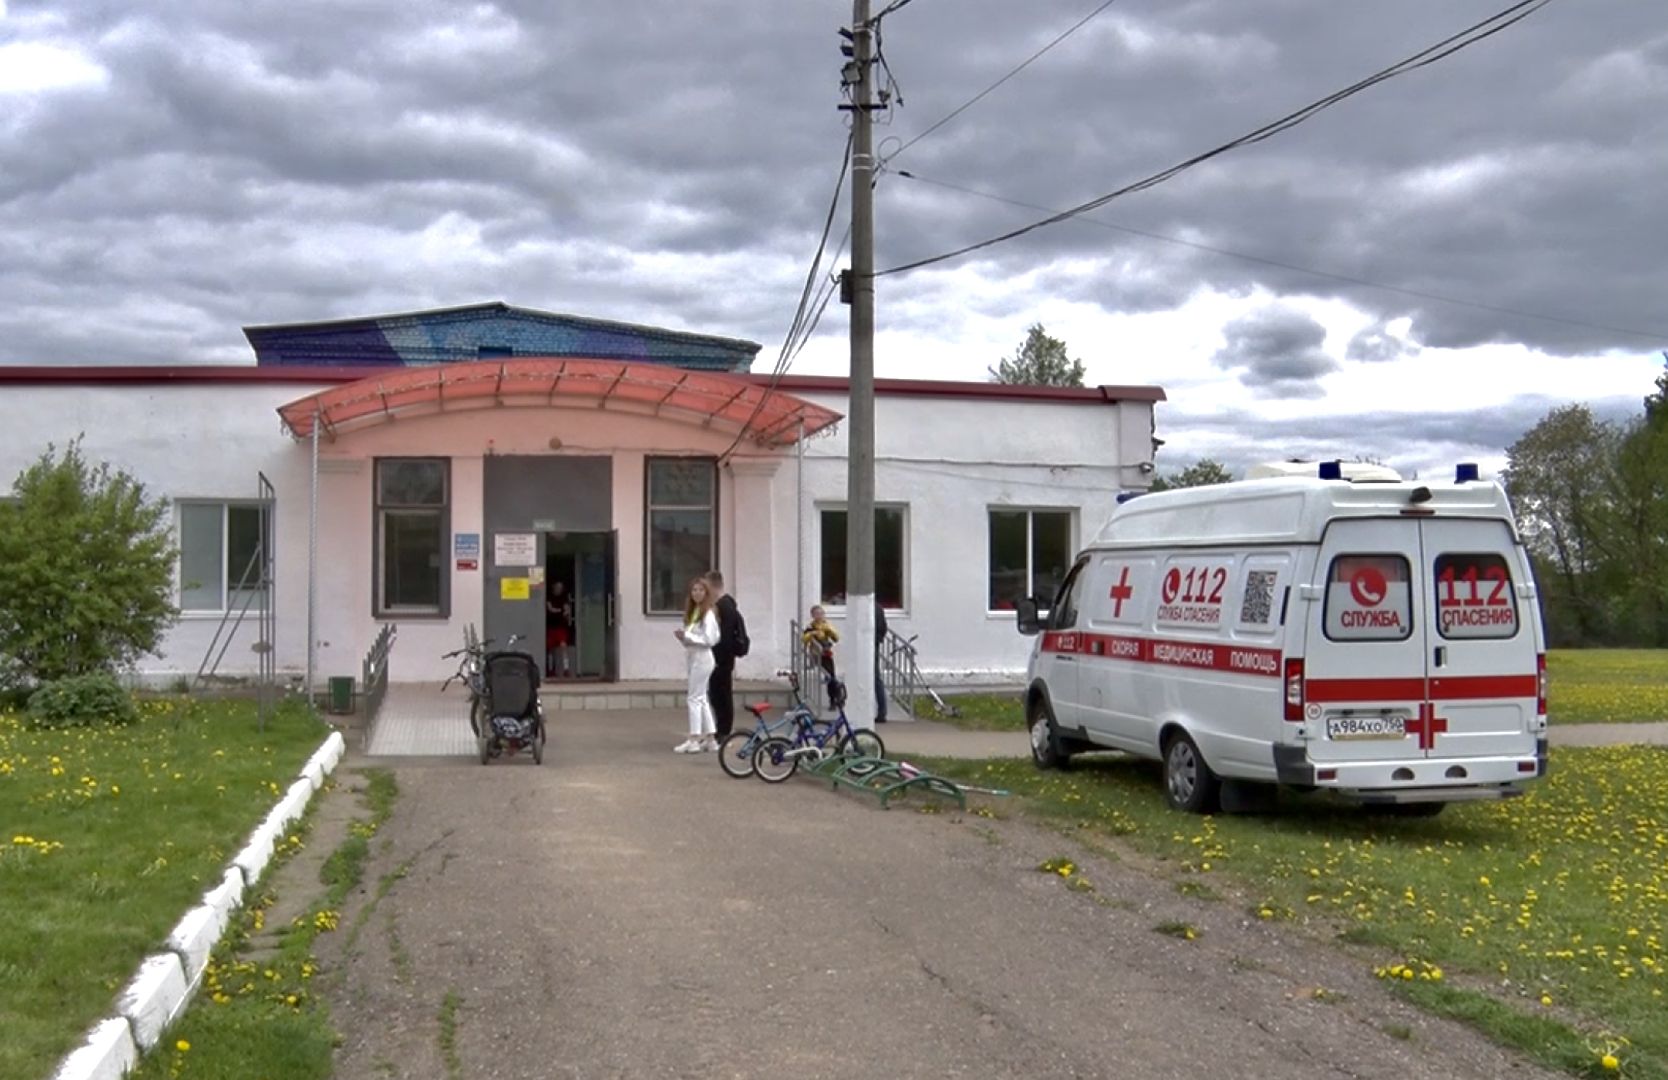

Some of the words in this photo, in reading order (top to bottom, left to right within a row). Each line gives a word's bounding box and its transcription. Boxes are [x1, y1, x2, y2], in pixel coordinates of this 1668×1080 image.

[1182, 567, 1226, 604] 112
[1439, 563, 1508, 607] 112
[1157, 606, 1182, 621] СЛУЖБА
[1184, 607, 1220, 623] СПАСЕНИЯ
[1341, 611, 1400, 628] СЛУЖБА
[1442, 608, 1513, 626] СПАСЕНИЯ
[1112, 640, 1139, 656] СКОРАЯ
[1154, 644, 1214, 665] МЕДИЦИНСКАЯ
[1231, 651, 1277, 674] ПОМОЩЬ
